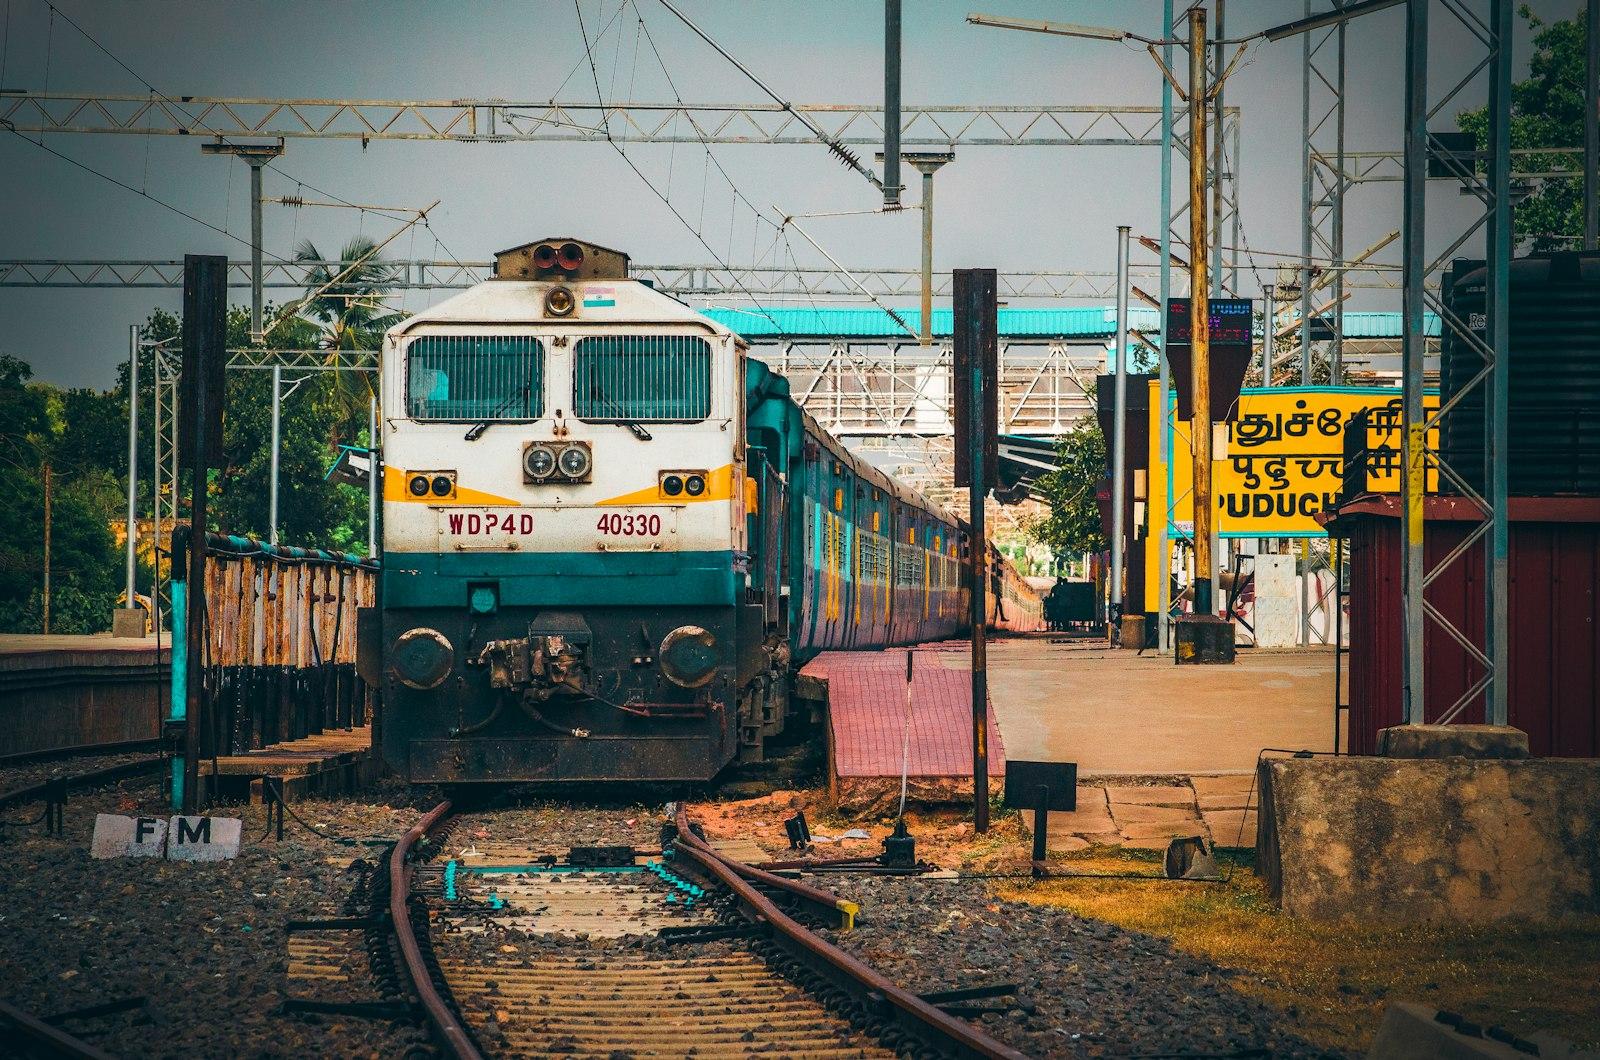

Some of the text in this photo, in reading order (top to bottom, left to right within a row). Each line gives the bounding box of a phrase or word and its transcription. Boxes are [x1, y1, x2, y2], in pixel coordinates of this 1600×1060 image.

[1470, 313, 1487, 329] Re
[1219, 492, 1343, 518] UDUCH
[449, 513, 661, 536] WDP4D 40330
